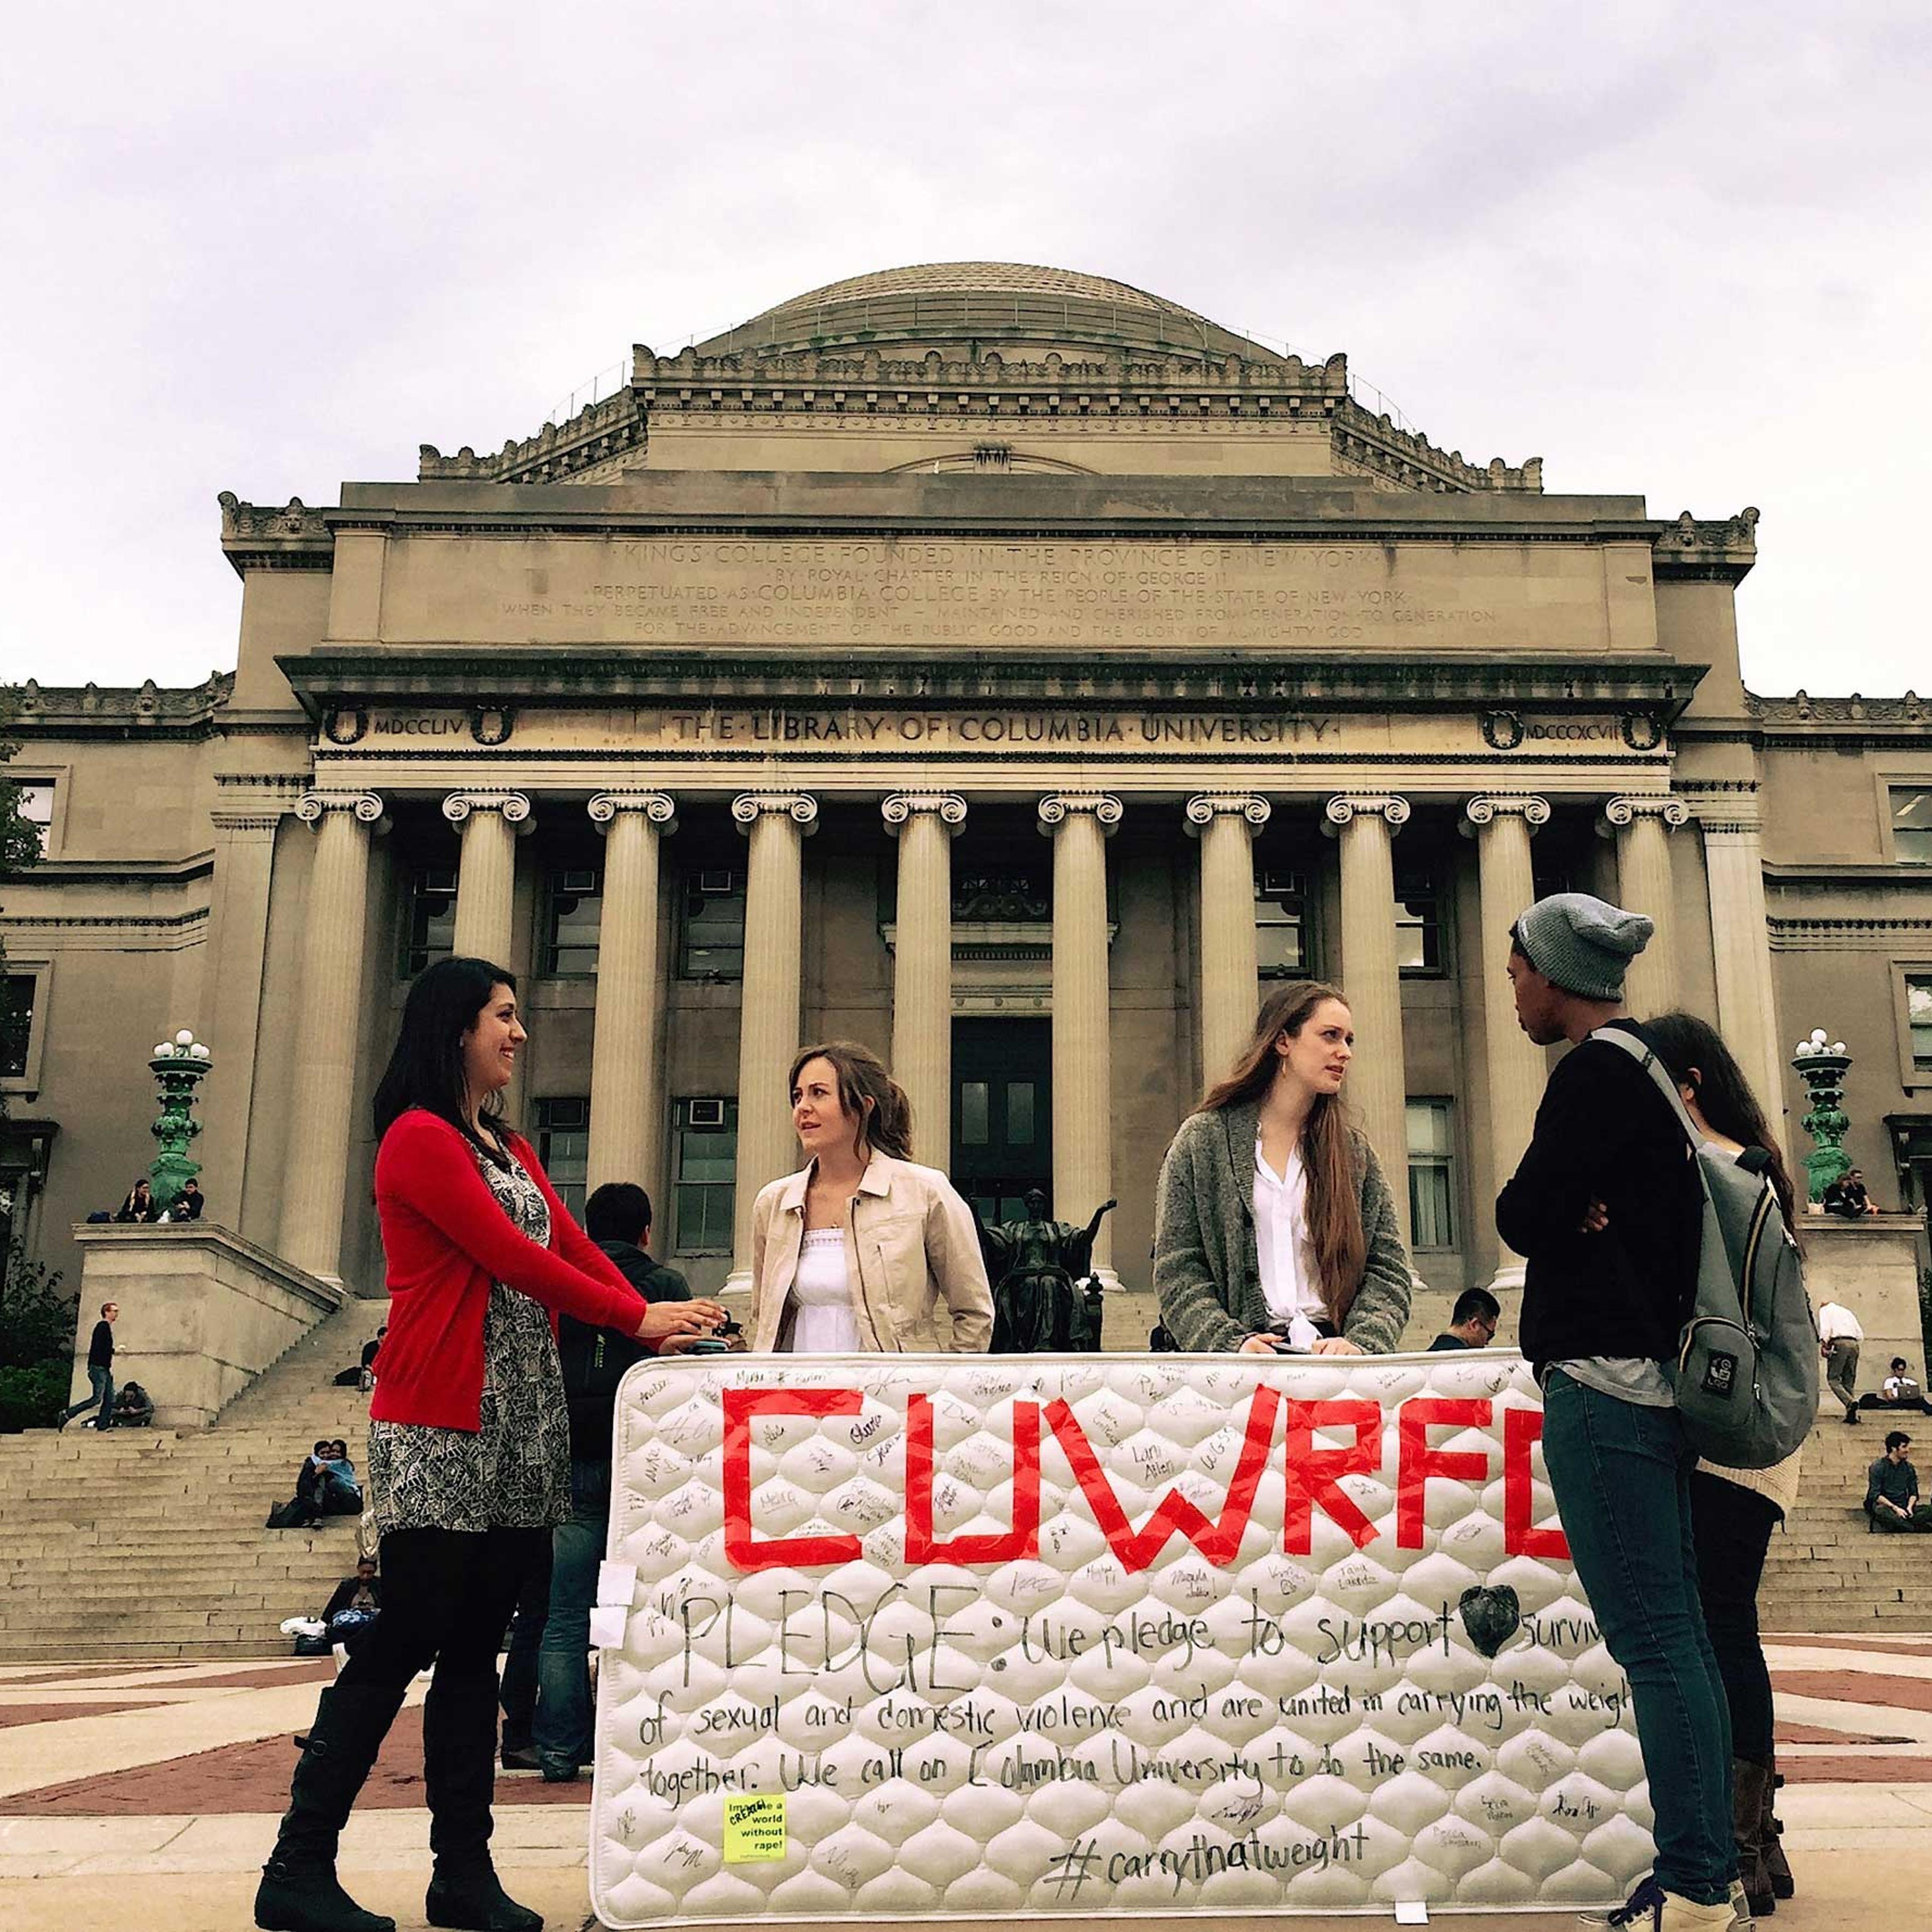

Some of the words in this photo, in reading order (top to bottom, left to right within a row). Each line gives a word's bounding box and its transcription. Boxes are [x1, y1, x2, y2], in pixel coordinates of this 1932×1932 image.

[716, 546, 826, 563] COLLEGE
[841, 547, 953, 564] FOUNDED
[971, 548, 993, 565] IN
[1007, 548, 1054, 566] THE
[1070, 549, 1186, 566] PROVINCE
[1200, 549, 1230, 566] OF
[776, 569, 794, 582] BY
[809, 569, 863, 582] ROYAL
[874, 569, 953, 583] CHARTER
[965, 571, 983, 584] IN
[993, 571, 1028, 584] THE
[1040, 571, 1091, 584] REIGN
[1103, 572, 1126, 584] OF
[1137, 572, 1206, 585] GEORGE
[594, 586, 717, 600] PERPETUATED
[728, 587, 748, 600] AS
[758, 585, 870, 601] COLUMBIA
[880, 586, 978, 602] COLLEGE
[990, 589, 1009, 602] BY
[1019, 589, 1056, 602] THE
[1066, 589, 1128, 603] PEOPLE
[1138, 590, 1161, 603] OF
[1170, 590, 1205, 603] THE
[1217, 590, 1264, 604] STATE
[1276, 591, 1298, 604] OF
[1309, 591, 1346, 604] NEW
[1358, 591, 1407, 605] YORK
[505, 604, 551, 616] WHEN
[562, 604, 603, 617] THEY
[615, 605, 678, 617] BECAME
[689, 606, 728, 618] FREE
[739, 606, 773, 618] AND
[785, 606, 900, 618] INDEPENDENT
[1359, 610, 1384, 622] TO
[1392, 610, 1495, 622] GENERATION
[635, 622, 666, 634] FOR
[676, 623, 708, 635] THE
[851, 624, 871, 636] OF
[881, 624, 912, 636] THE
[923, 625, 977, 637] PUBLIC
[990, 625, 1037, 637] GOOD
[1048, 625, 1081, 637] AND
[1093, 625, 1123, 637] THE
[1133, 626, 1184, 638] GLORY
[1197, 626, 1219, 638] OF
[374, 719, 462, 735] MDCCLIV
[672, 716, 734, 739] THE
[755, 716, 886, 740] LIBRARY
[900, 717, 942, 740] OF
[959, 717, 1125, 742] COLUMBIA
[1141, 719, 1331, 743] UNIVERSITY
[1526, 725, 1618, 740] MDCCCXCVII
[1102, 1612, 1215, 1671] pledge
[1241, 1587, 1285, 1658] to
[639, 1689, 674, 1745] of
[695, 1696, 779, 1735] sexual
[805, 1696, 852, 1727] and
[878, 1698, 995, 1735] domestic
[1016, 1695, 1131, 1732] violence
[1153, 1683, 1207, 1721] and
[1223, 1696, 1263, 1718] are
[1279, 1685, 1350, 1717] united
[1363, 1691, 1382, 1712] in
[1398, 1692, 1503, 1730] carrying
[1507, 1680, 1553, 1716] the
[639, 1759, 758, 1811] together.
[780, 1751, 838, 1792] We
[861, 1747, 903, 1783] call
[919, 1759, 947, 1782] on
[1112, 1739, 1263, 1796] University
[1268, 1742, 1306, 1779] to
[1319, 1744, 1345, 1776] do
[1363, 1742, 1404, 1777] the
[1418, 1749, 1481, 1770] same.
[752, 1815, 782, 1824] world
[741, 1828, 782, 1837] without
[755, 1841, 782, 1851] rape!
